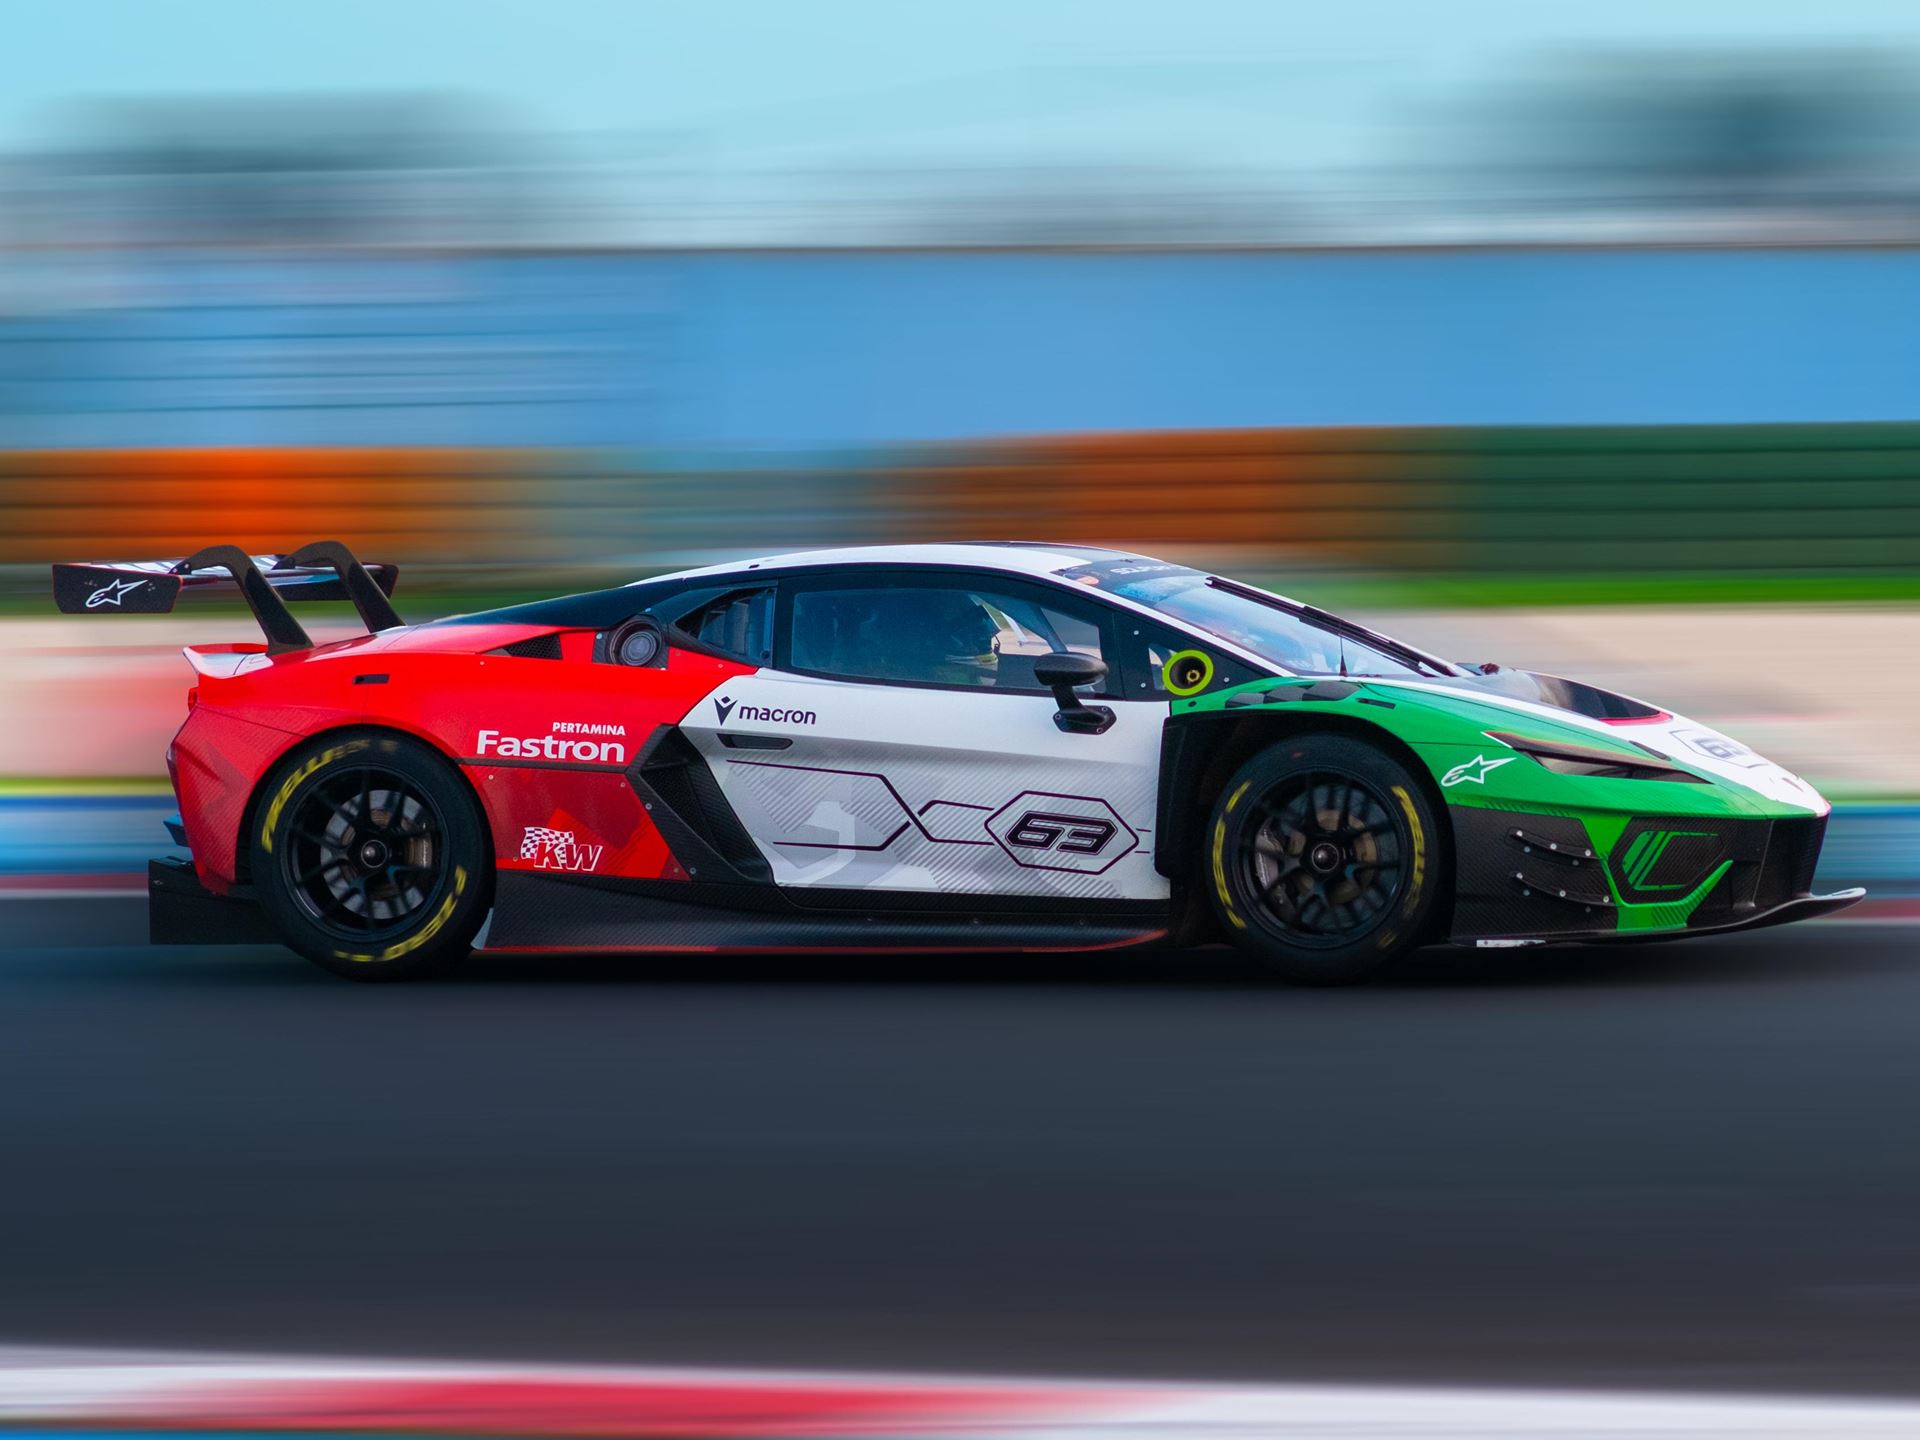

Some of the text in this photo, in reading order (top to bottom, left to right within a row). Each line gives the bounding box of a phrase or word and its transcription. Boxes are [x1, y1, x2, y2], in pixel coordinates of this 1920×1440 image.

[552, 722, 625, 736] PERTAMINA
[739, 706, 816, 725] macron
[476, 729, 625, 763] Fastron
[1005, 810, 1119, 856] 63
[533, 842, 603, 872] KW
